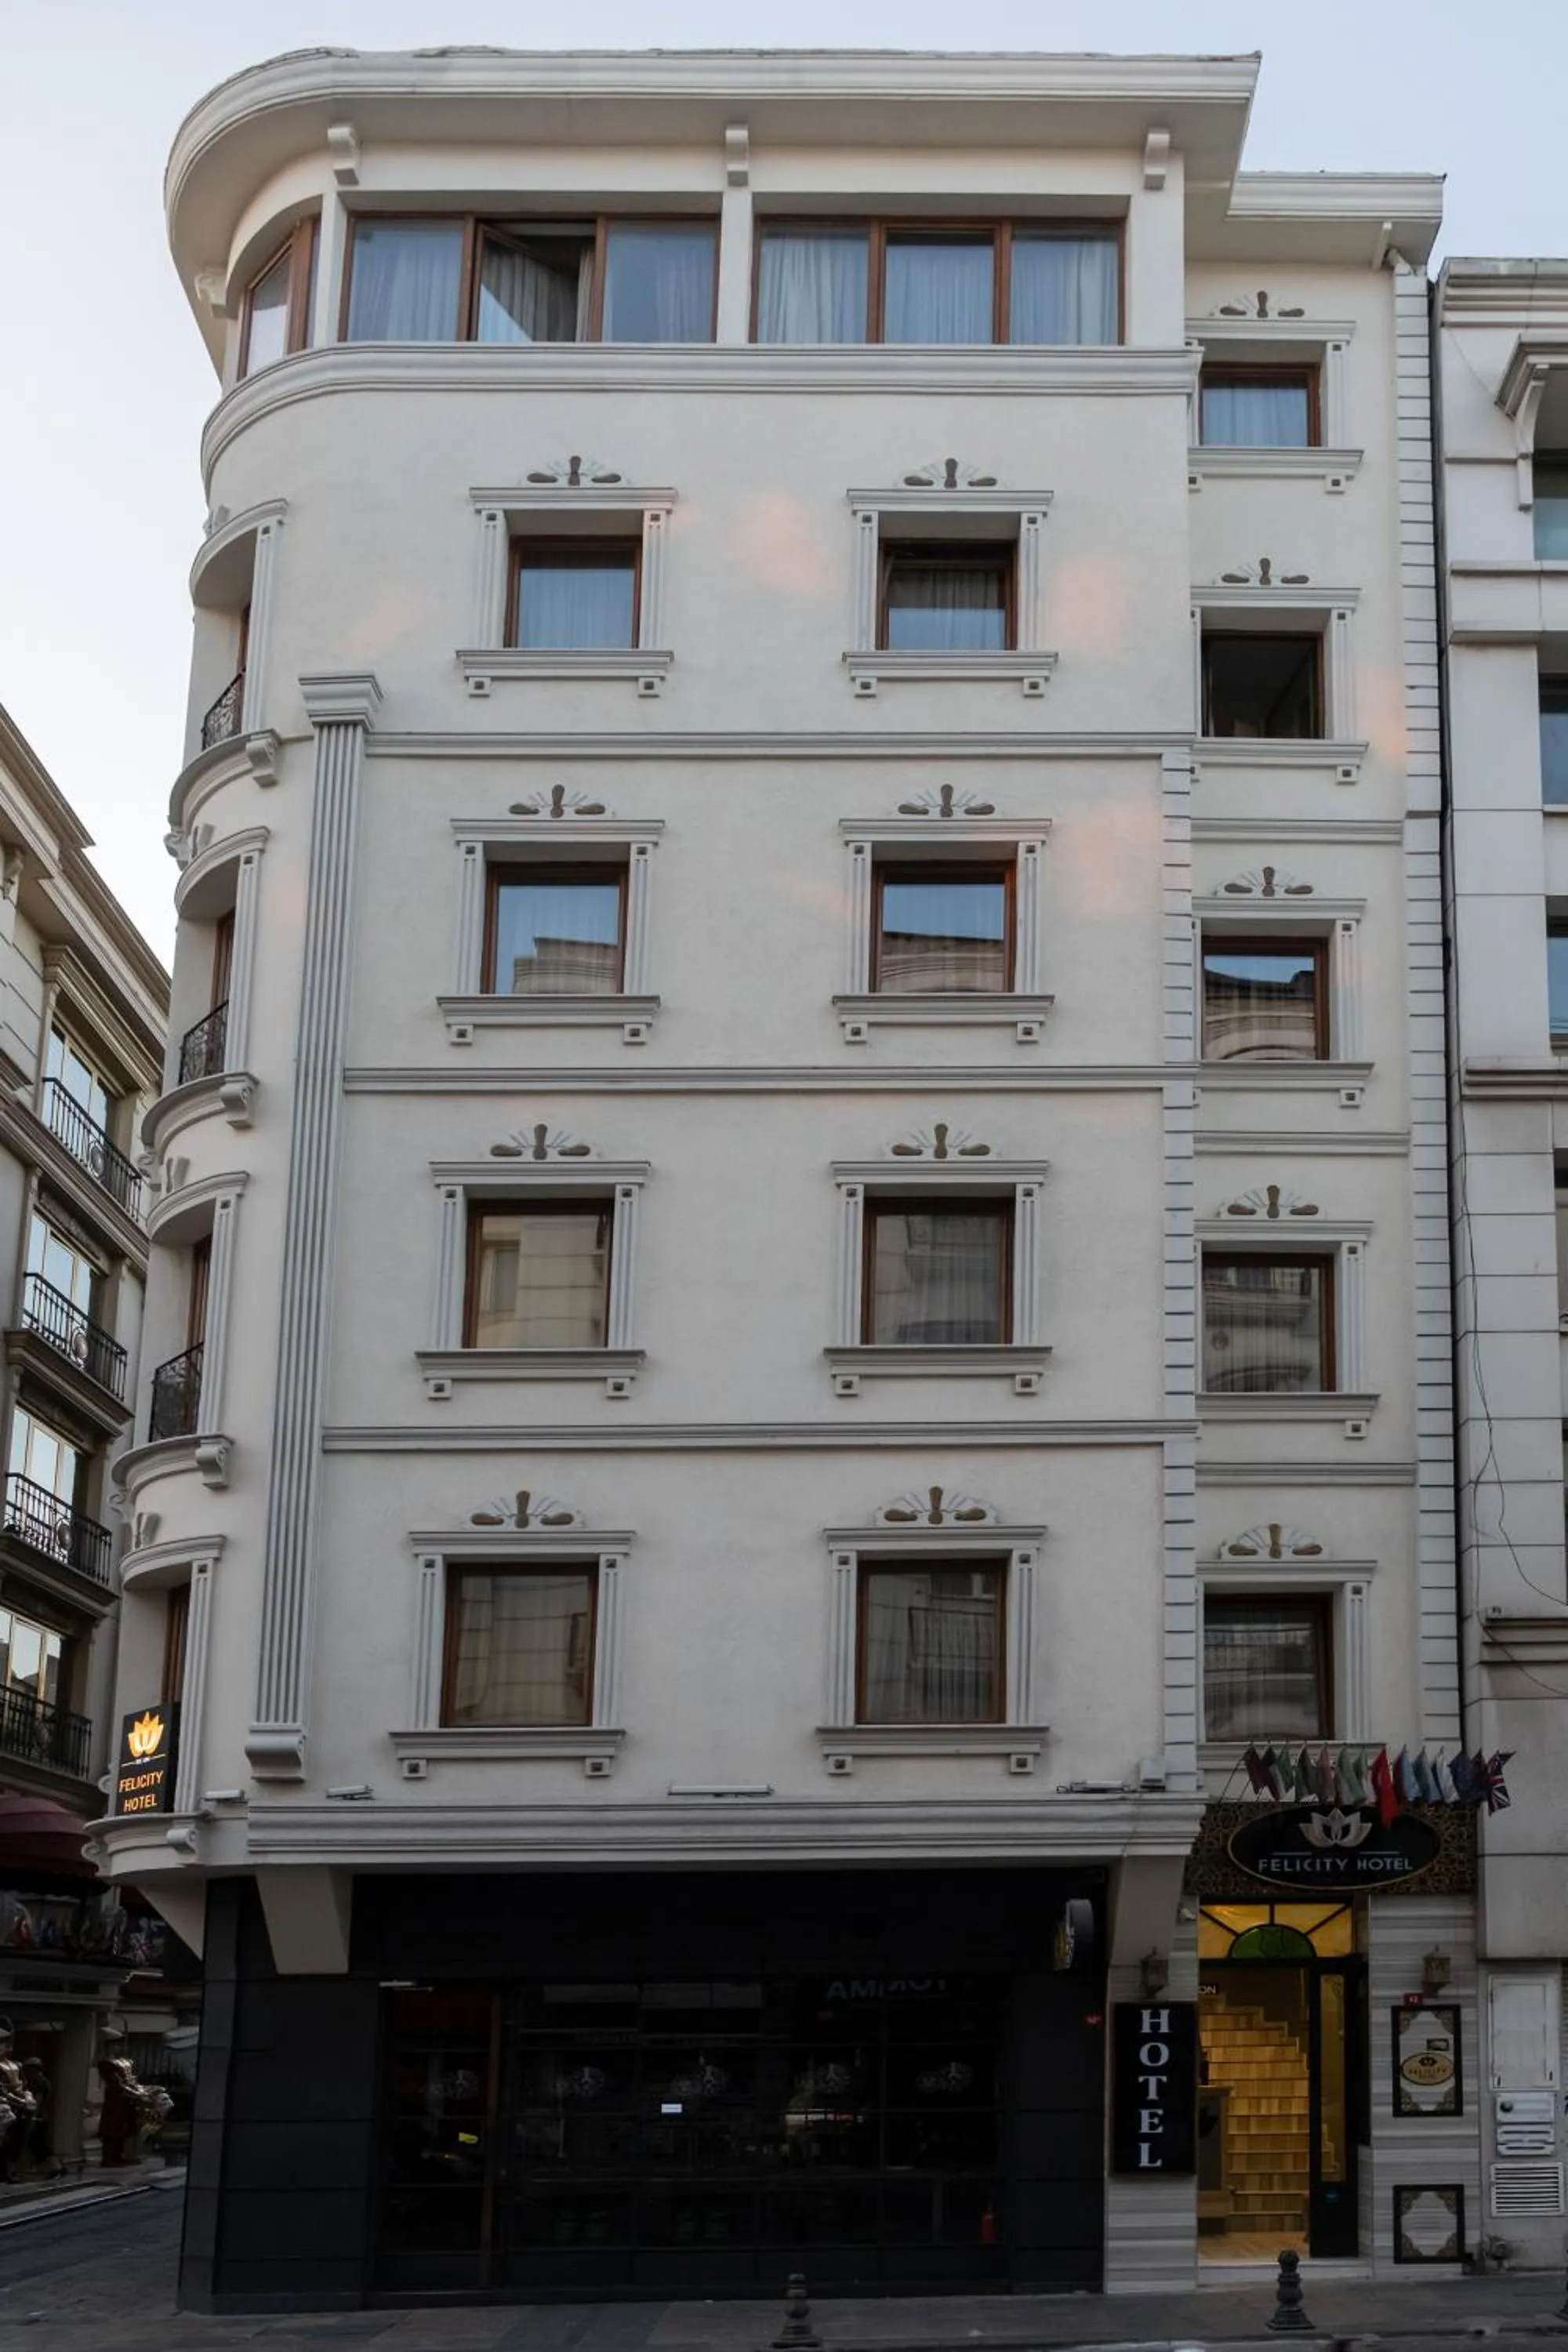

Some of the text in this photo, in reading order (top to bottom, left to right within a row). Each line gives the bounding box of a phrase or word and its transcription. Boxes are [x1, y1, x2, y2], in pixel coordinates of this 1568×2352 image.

[118, 1769, 164, 1793] FELICITY
[123, 1793, 158, 1813] HOTEL
[1258, 1857, 1414, 1873] FELICITY HOTEL
[1138, 2009, 1171, 2167] HOTEL
